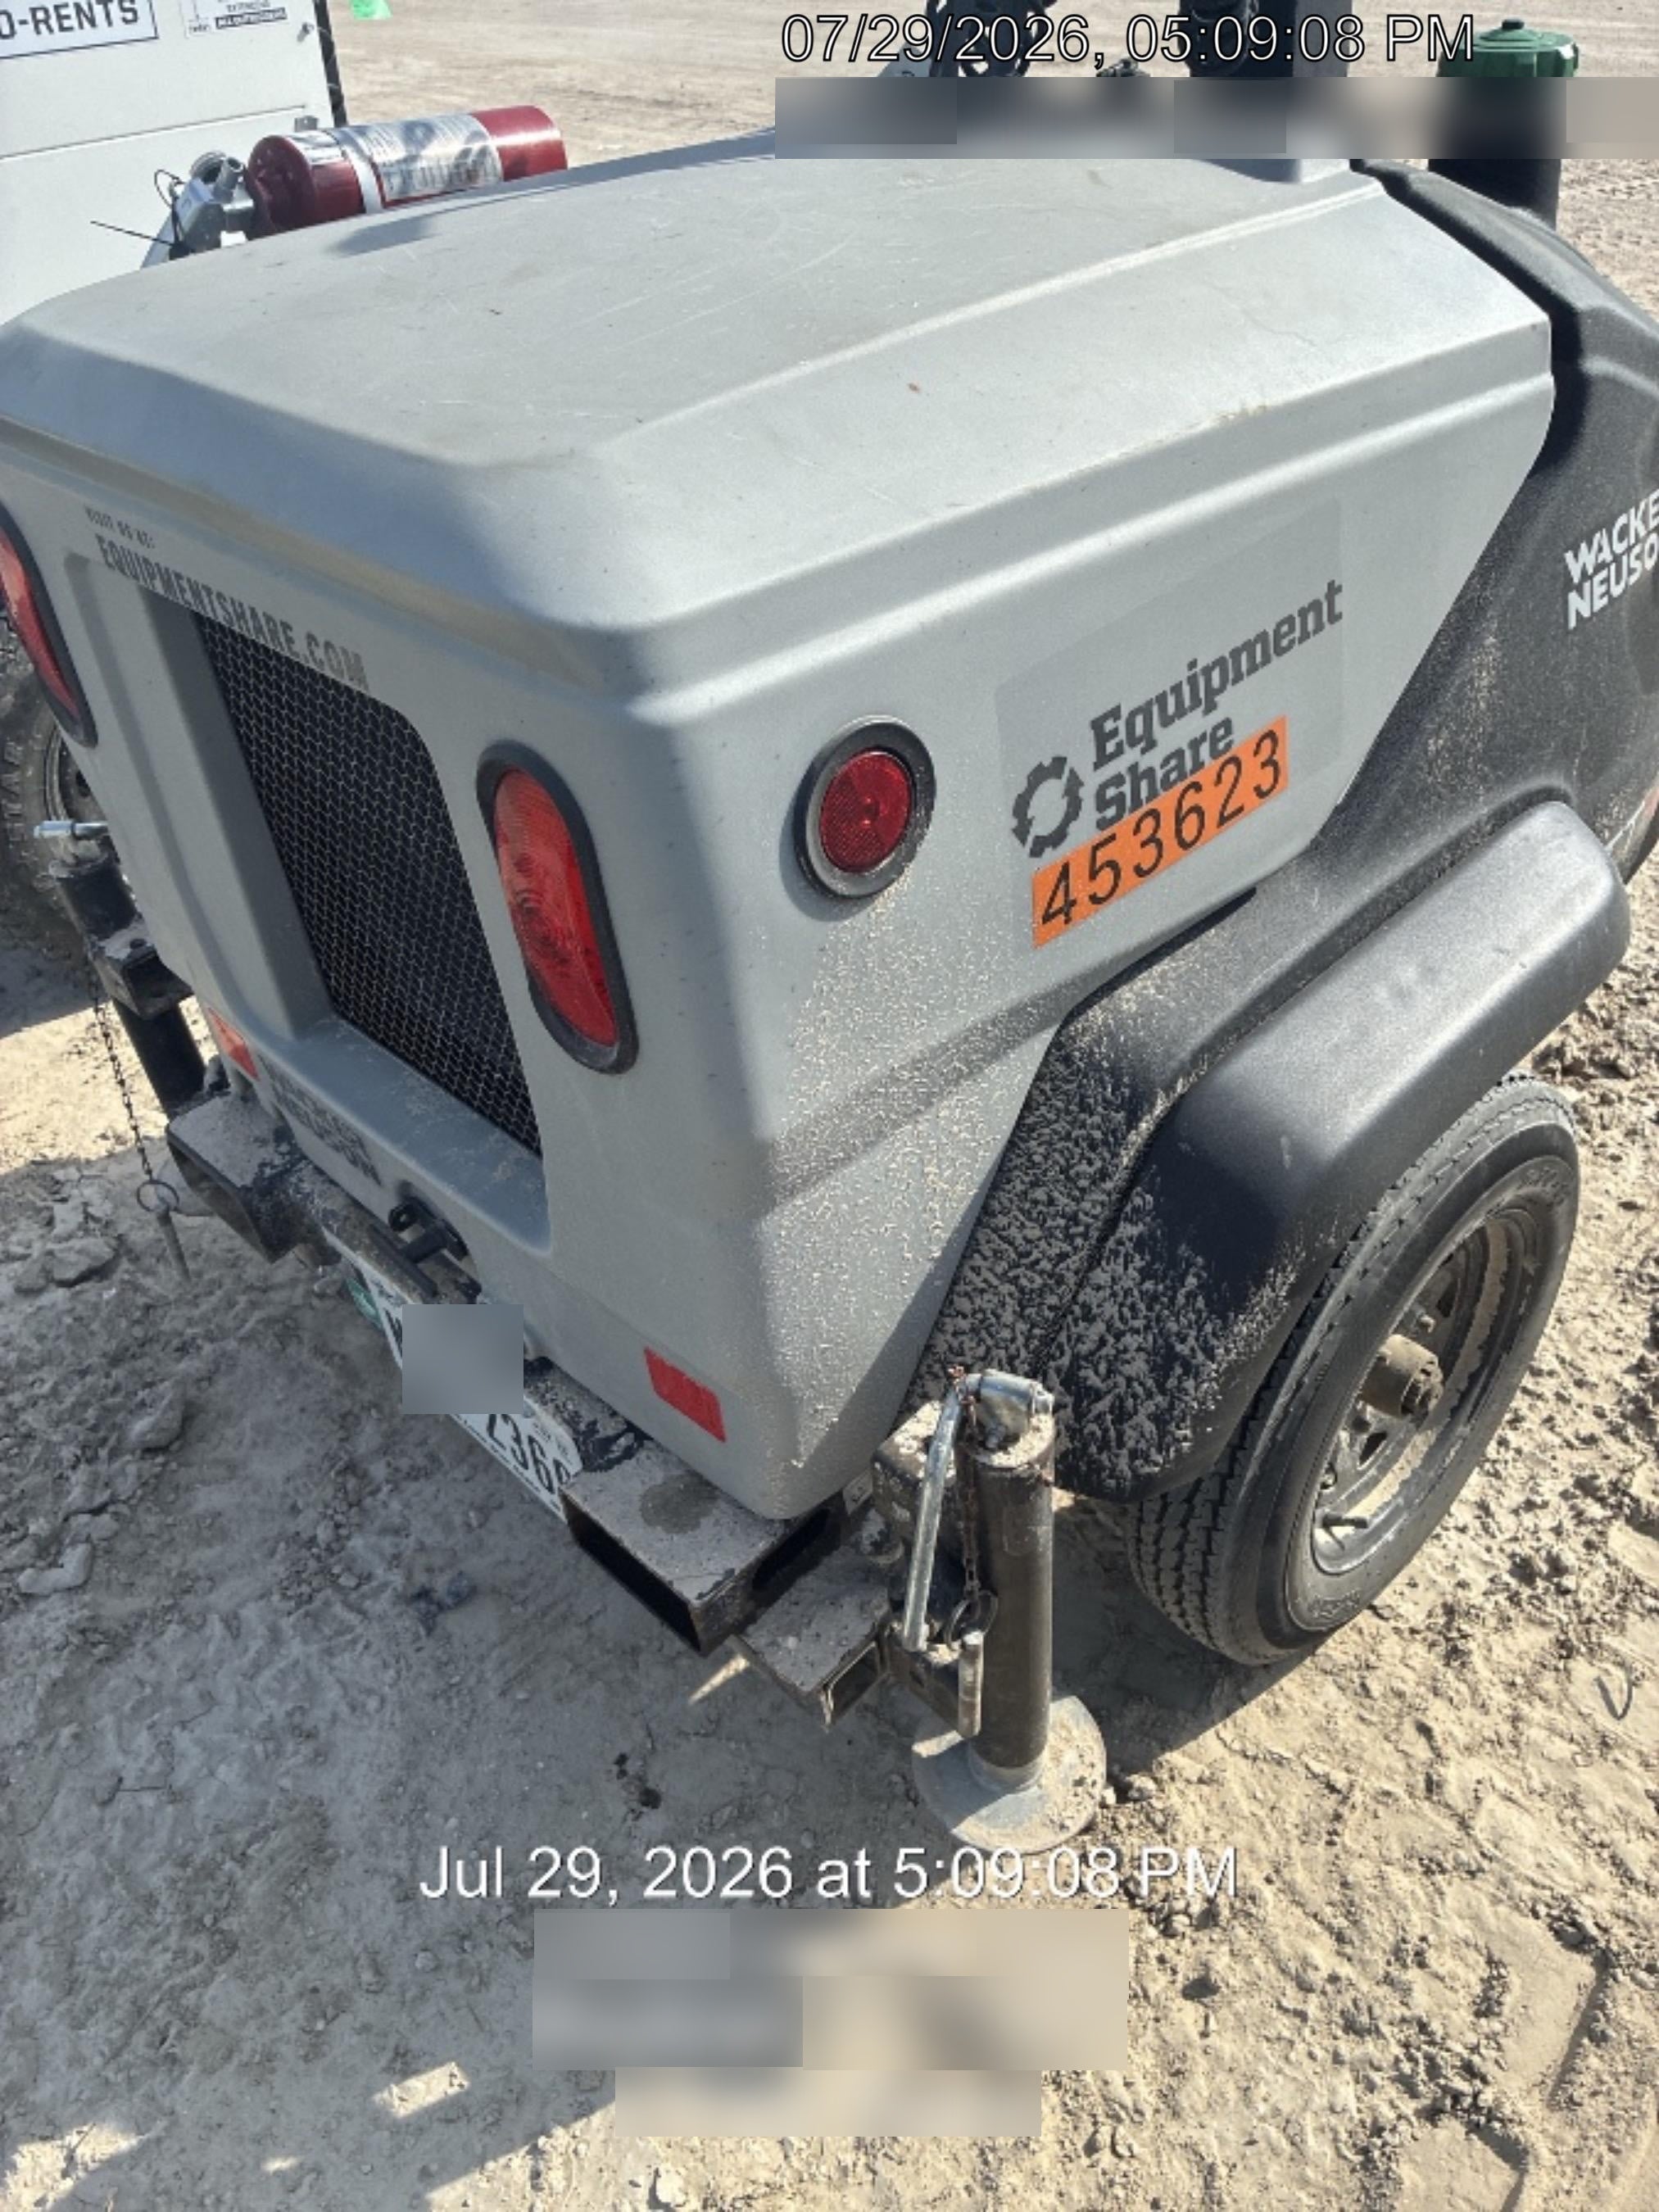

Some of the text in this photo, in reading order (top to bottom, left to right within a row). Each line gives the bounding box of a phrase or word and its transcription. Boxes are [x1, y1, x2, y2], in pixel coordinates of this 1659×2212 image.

[1564, 488, 1659, 584] WACKE
[1567, 533, 1659, 630] NEUSO
[94, 533, 370, 692] EQUIPMENTSHARE.COM
[1090, 578, 1343, 772] Equipment
[1041, 728, 1281, 926] 453623
[1095, 716, 1233, 832] Share
